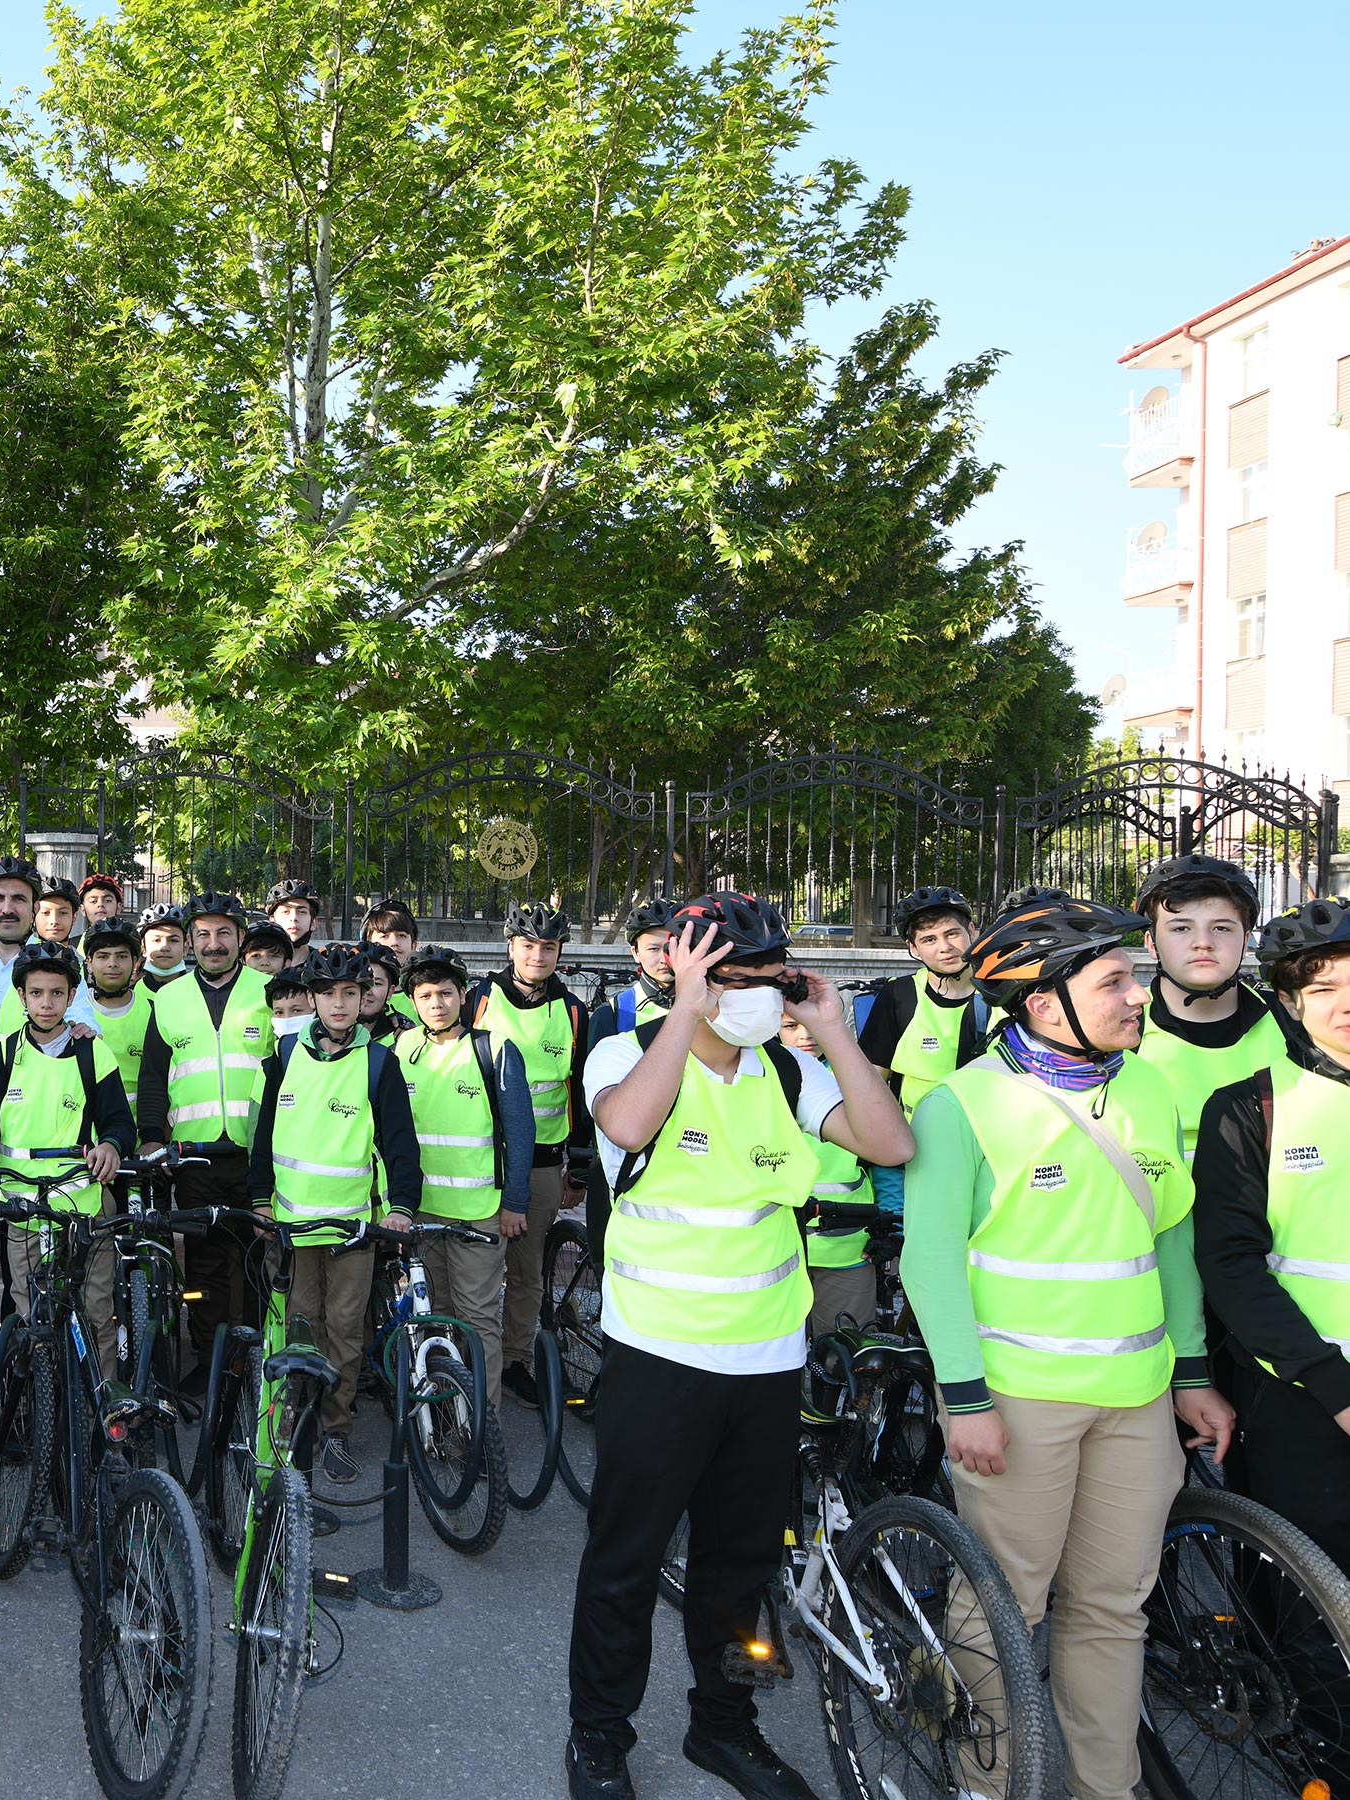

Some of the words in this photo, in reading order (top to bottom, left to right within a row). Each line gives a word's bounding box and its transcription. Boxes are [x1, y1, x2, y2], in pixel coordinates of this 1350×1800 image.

[683, 1130, 708, 1140] KONYA
[1284, 1146, 1318, 1155] KONYA
[755, 1153, 786, 1172] Konya
[1035, 1164, 1061, 1174] KONYA
[1140, 1166, 1167, 1182] onya
